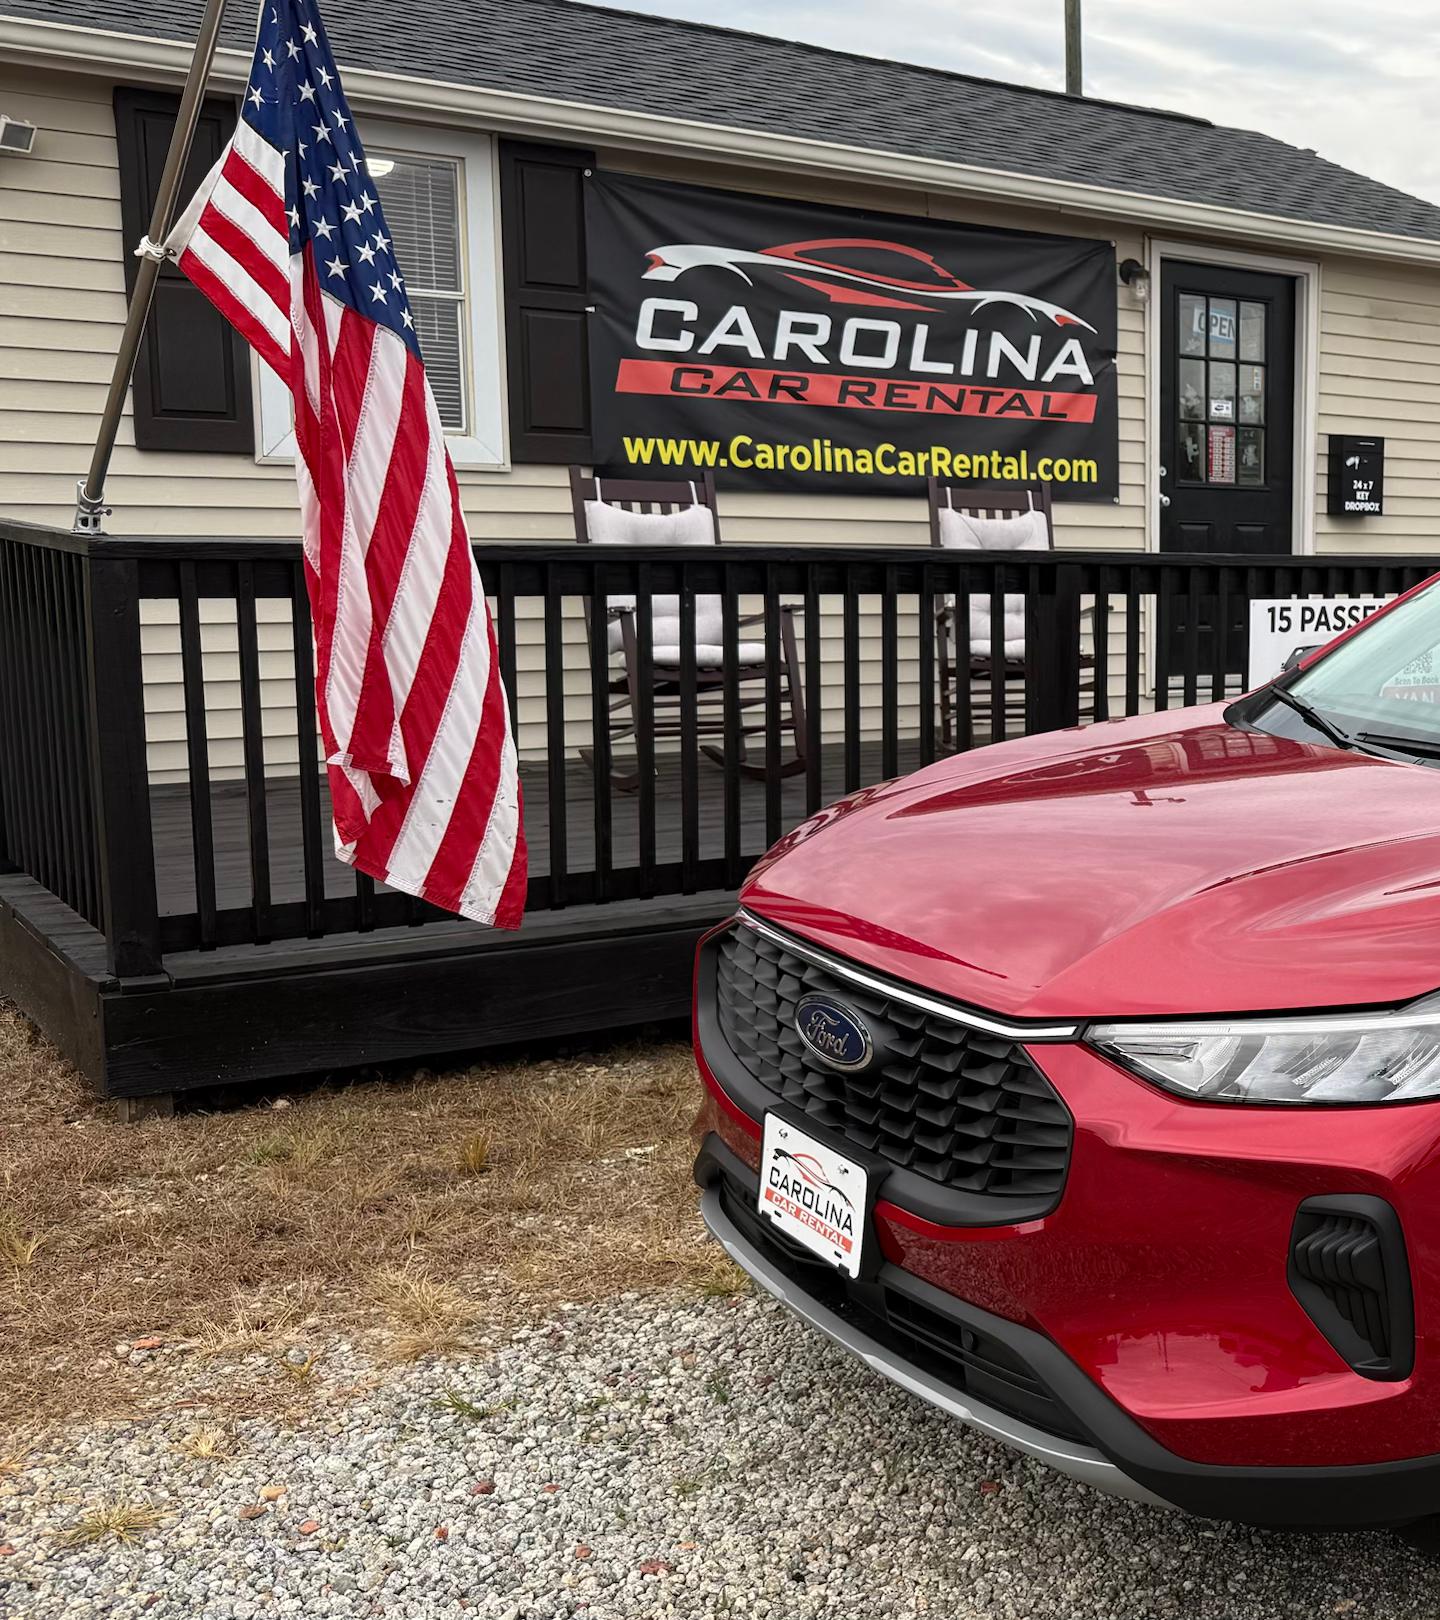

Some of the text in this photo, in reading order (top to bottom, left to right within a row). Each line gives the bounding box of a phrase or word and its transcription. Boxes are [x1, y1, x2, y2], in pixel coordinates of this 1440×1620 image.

[634, 297, 1095, 386] CAROLINA
[1197, 311, 1236, 338] OPEN
[670, 366, 1068, 419] CAR RENTAL
[623, 434, 1098, 483] www.CarolinaCarRental.com
[1344, 501, 1380, 512] DROPBOX
[1352, 480, 1362, 490] 24
[1368, 481, 1374, 490] 7
[1355, 491, 1370, 500] KEY
[1267, 606, 1292, 633] 15
[807, 1010, 848, 1056] Ford
[769, 1166, 854, 1236] CAROLINA
[772, 1192, 847, 1249] CAR RENTAL
